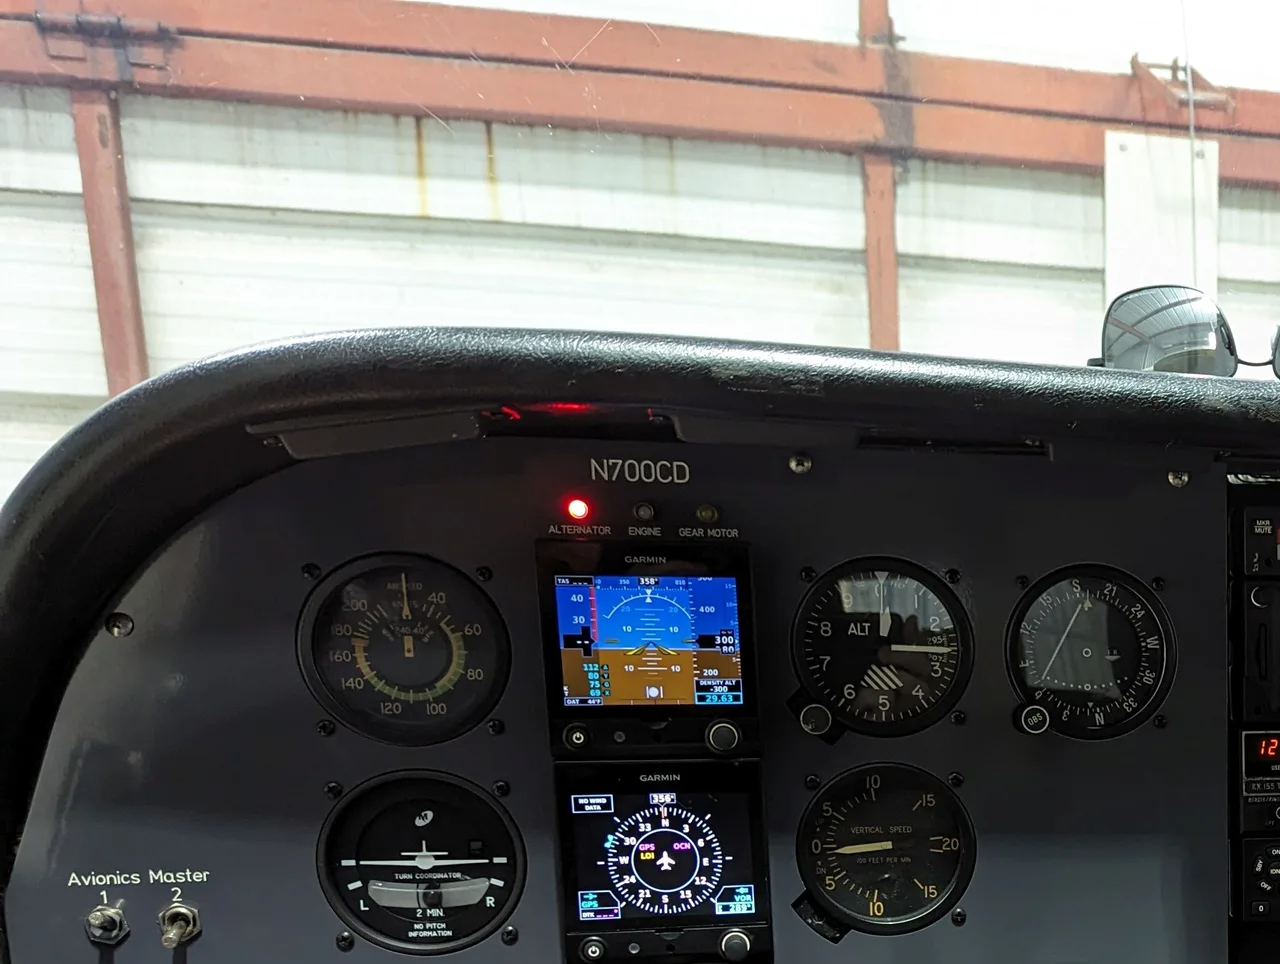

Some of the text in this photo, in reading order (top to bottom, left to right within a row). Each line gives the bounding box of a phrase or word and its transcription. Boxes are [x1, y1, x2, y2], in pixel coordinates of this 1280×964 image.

[591, 459, 690, 483] N700CD
[549, 526, 611, 535] ALTERNATOR
[629, 527, 661, 536] ENGINE
[679, 528, 738, 537] GEAR MOTOR
[1072, 580, 1081, 592] S
[1104, 584, 1117, 597] 21
[1131, 604, 1145, 619] 24
[848, 623, 870, 635] ALT
[330, 651, 351, 661] 160
[467, 670, 483, 680] 80
[342, 678, 364, 689] 140
[912, 685, 924, 698] 4
[381, 703, 401, 714] 120
[427, 704, 446, 714] 100
[879, 696, 889, 710] 5
[1028, 713, 1042, 725] OBS
[1095, 713, 1105, 725] N
[641, 852, 654, 860] LOI
[68, 869, 210, 886] Avionics Master
[825, 876, 836, 890] 5
[924, 886, 938, 898] 15
[870, 902, 884, 916] 10
